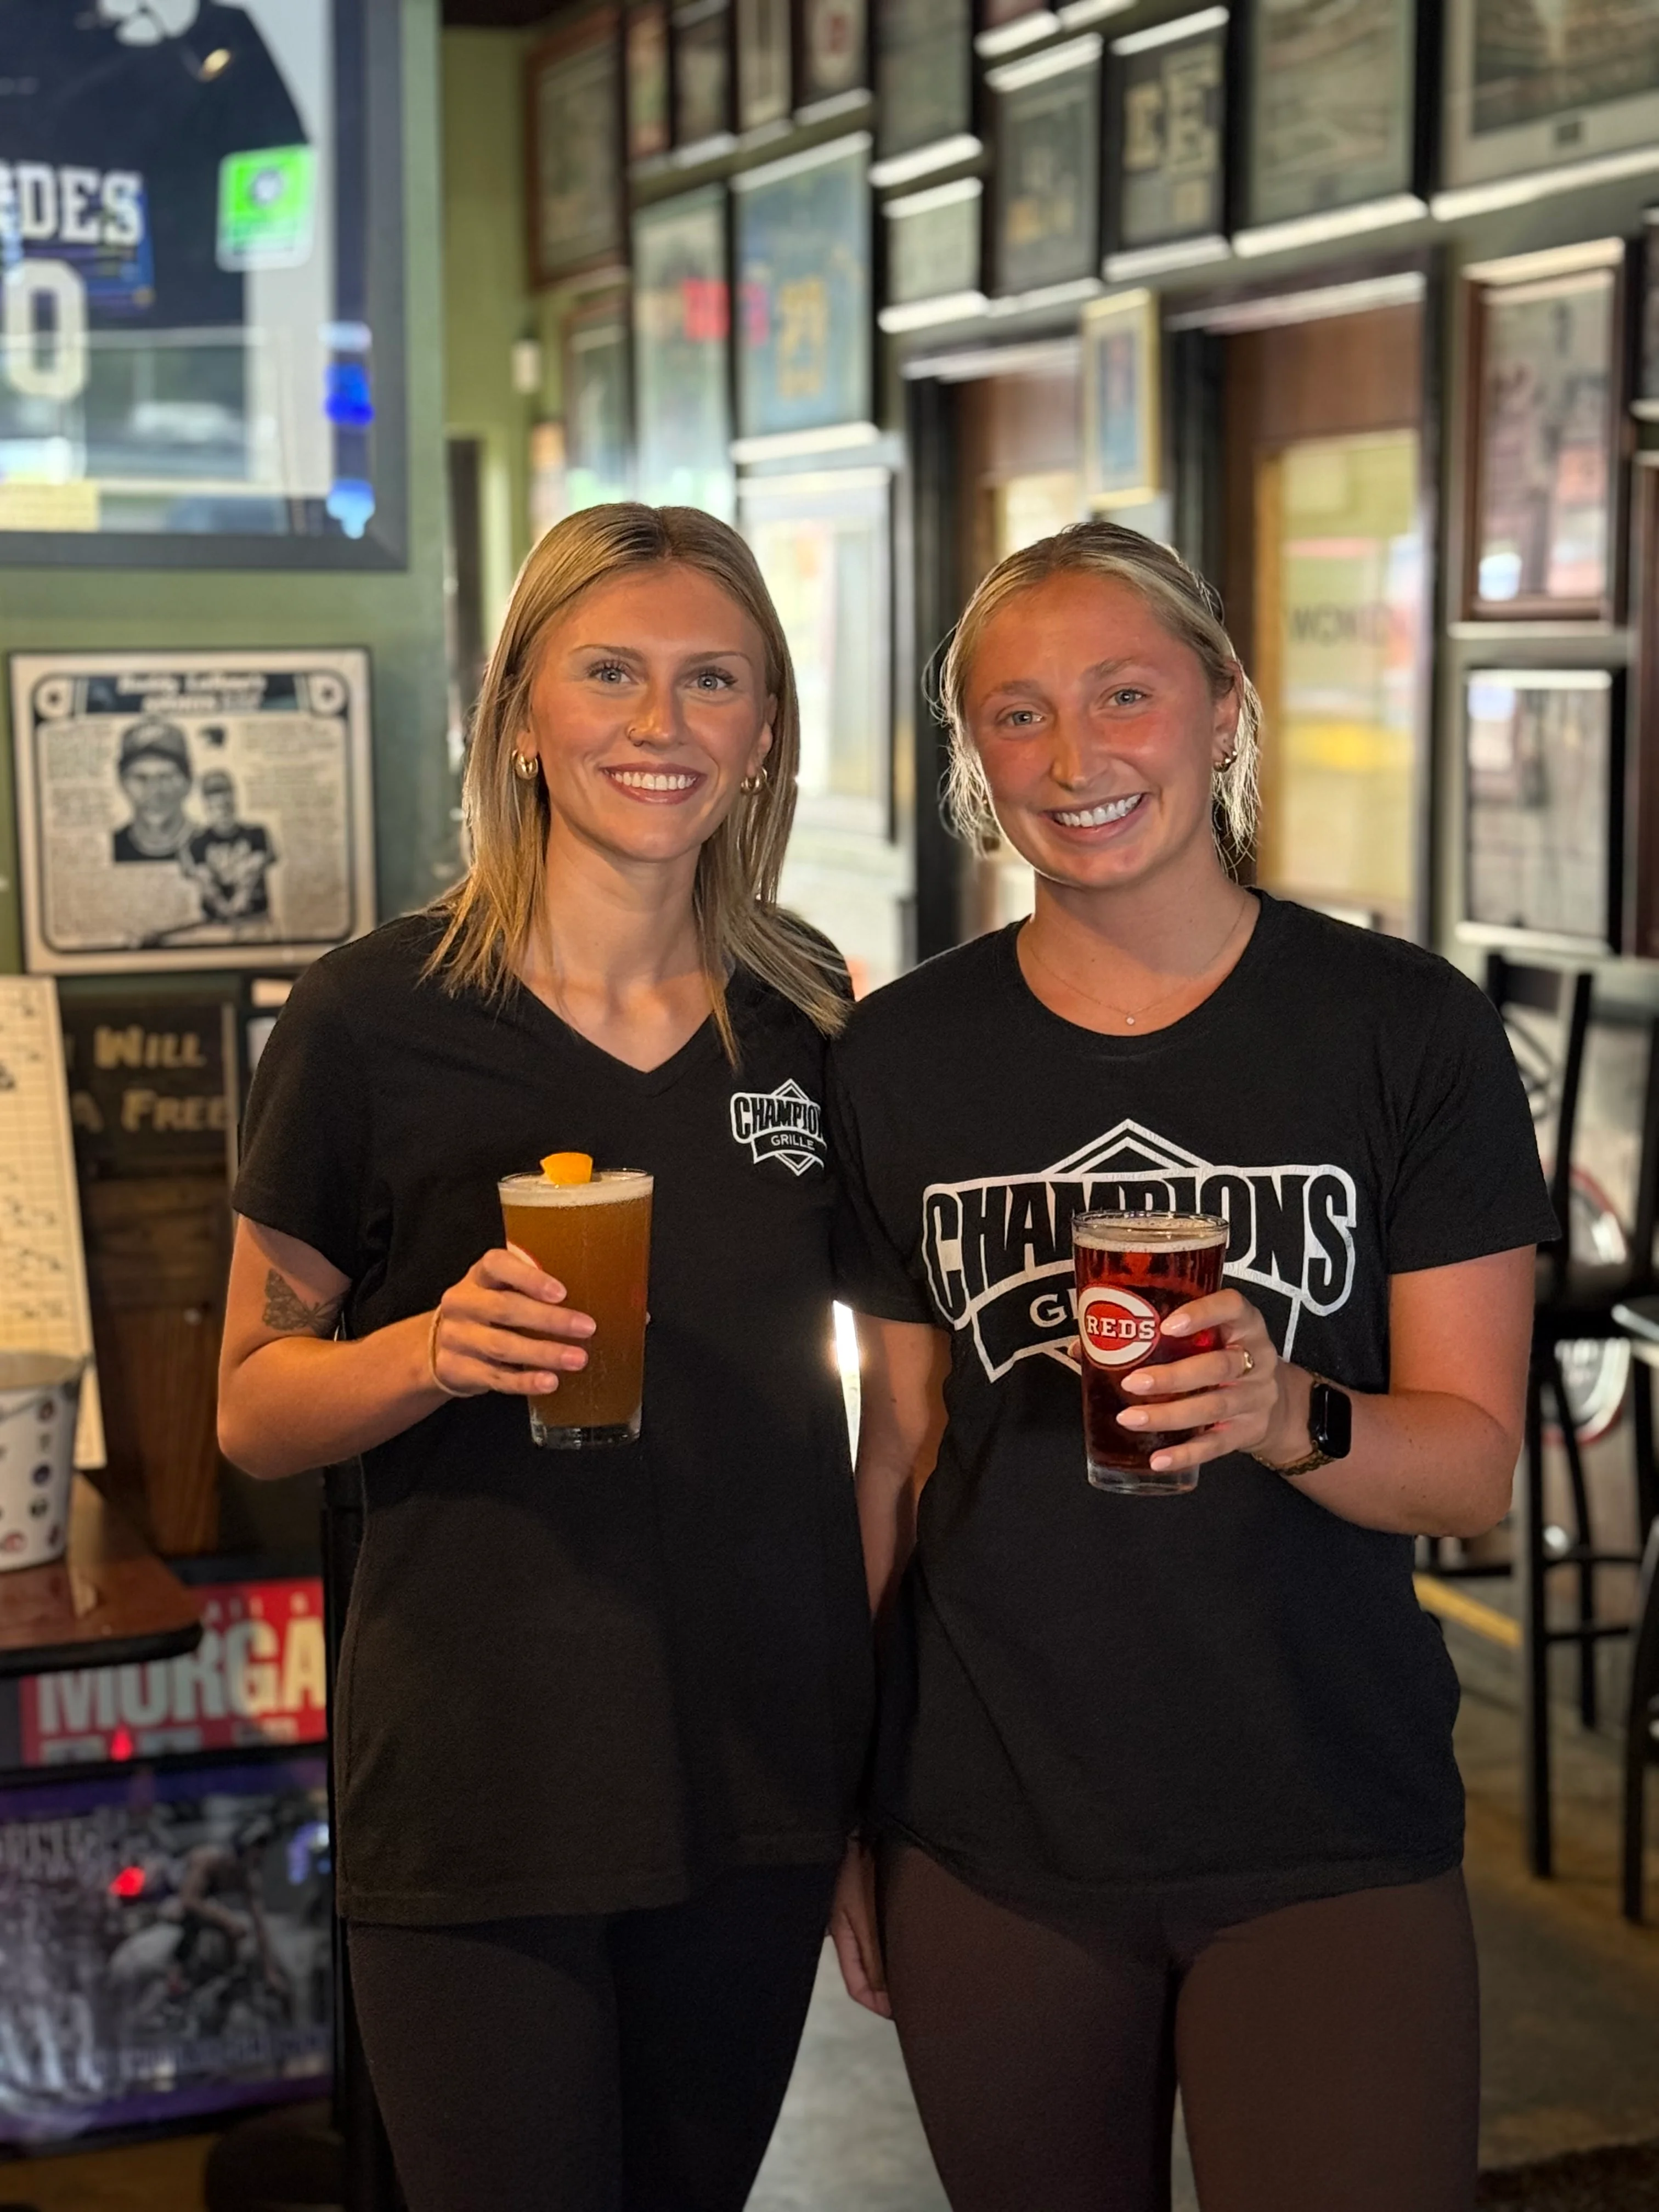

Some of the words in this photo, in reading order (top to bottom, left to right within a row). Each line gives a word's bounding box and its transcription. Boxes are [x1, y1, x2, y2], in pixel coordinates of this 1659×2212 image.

[93, 1024, 206, 1070] WILL
[732, 1094, 823, 1142] CHAMPIO
[771, 1134, 815, 1152] GRILLE
[1086, 1315, 1155, 1340] REDS
